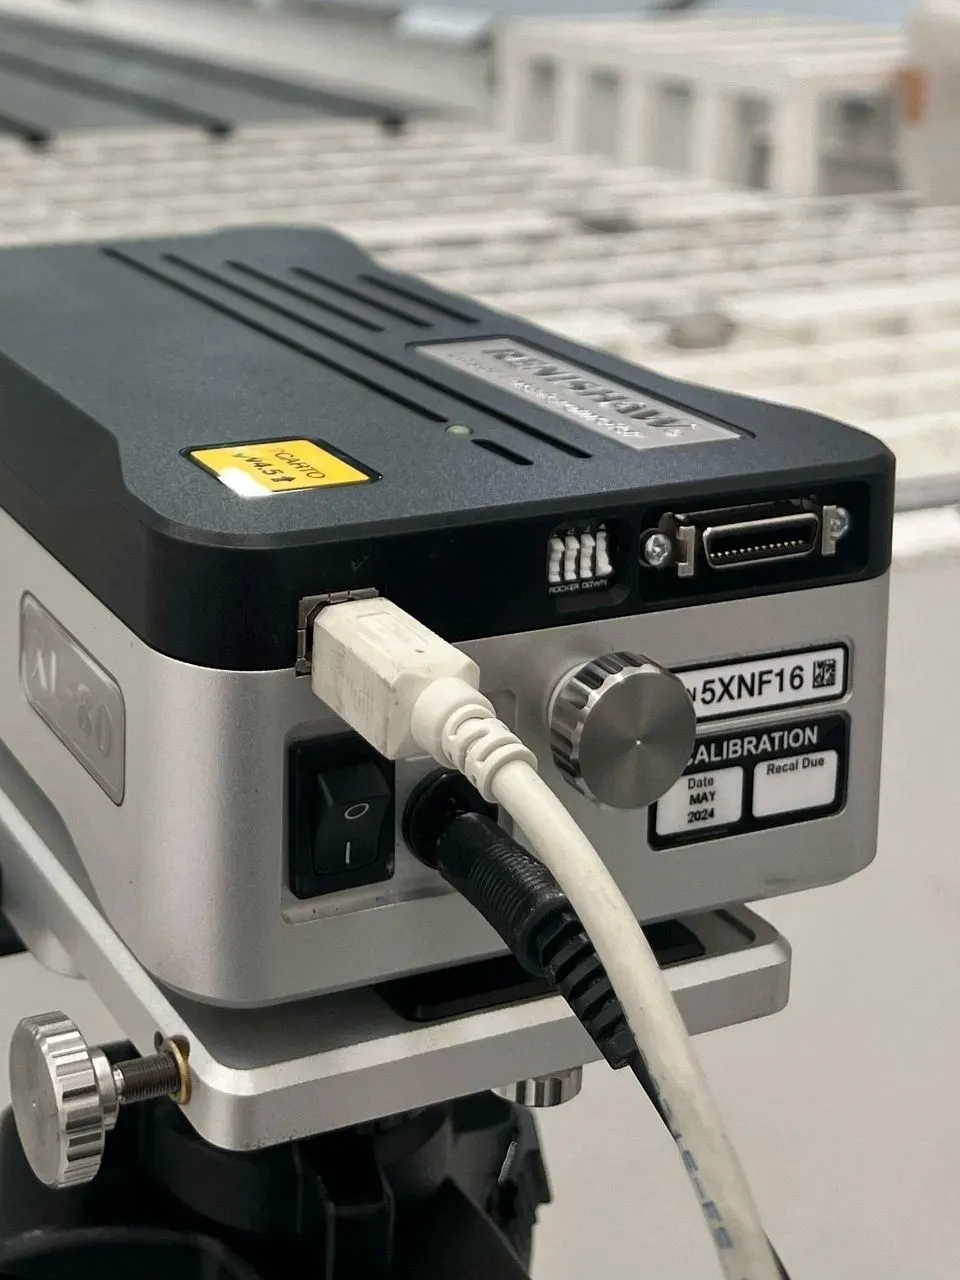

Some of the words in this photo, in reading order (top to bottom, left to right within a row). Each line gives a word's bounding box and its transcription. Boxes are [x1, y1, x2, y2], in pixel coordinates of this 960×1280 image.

[700, 664, 805, 705] 5XNF16
[690, 724, 819, 766] ALIBRATION
[765, 758, 800, 776] Recal
[801, 755, 825, 769] Due
[687, 776, 714, 790] Date
[689, 790, 716, 806] MAY
[687, 807, 715, 824] 2024
